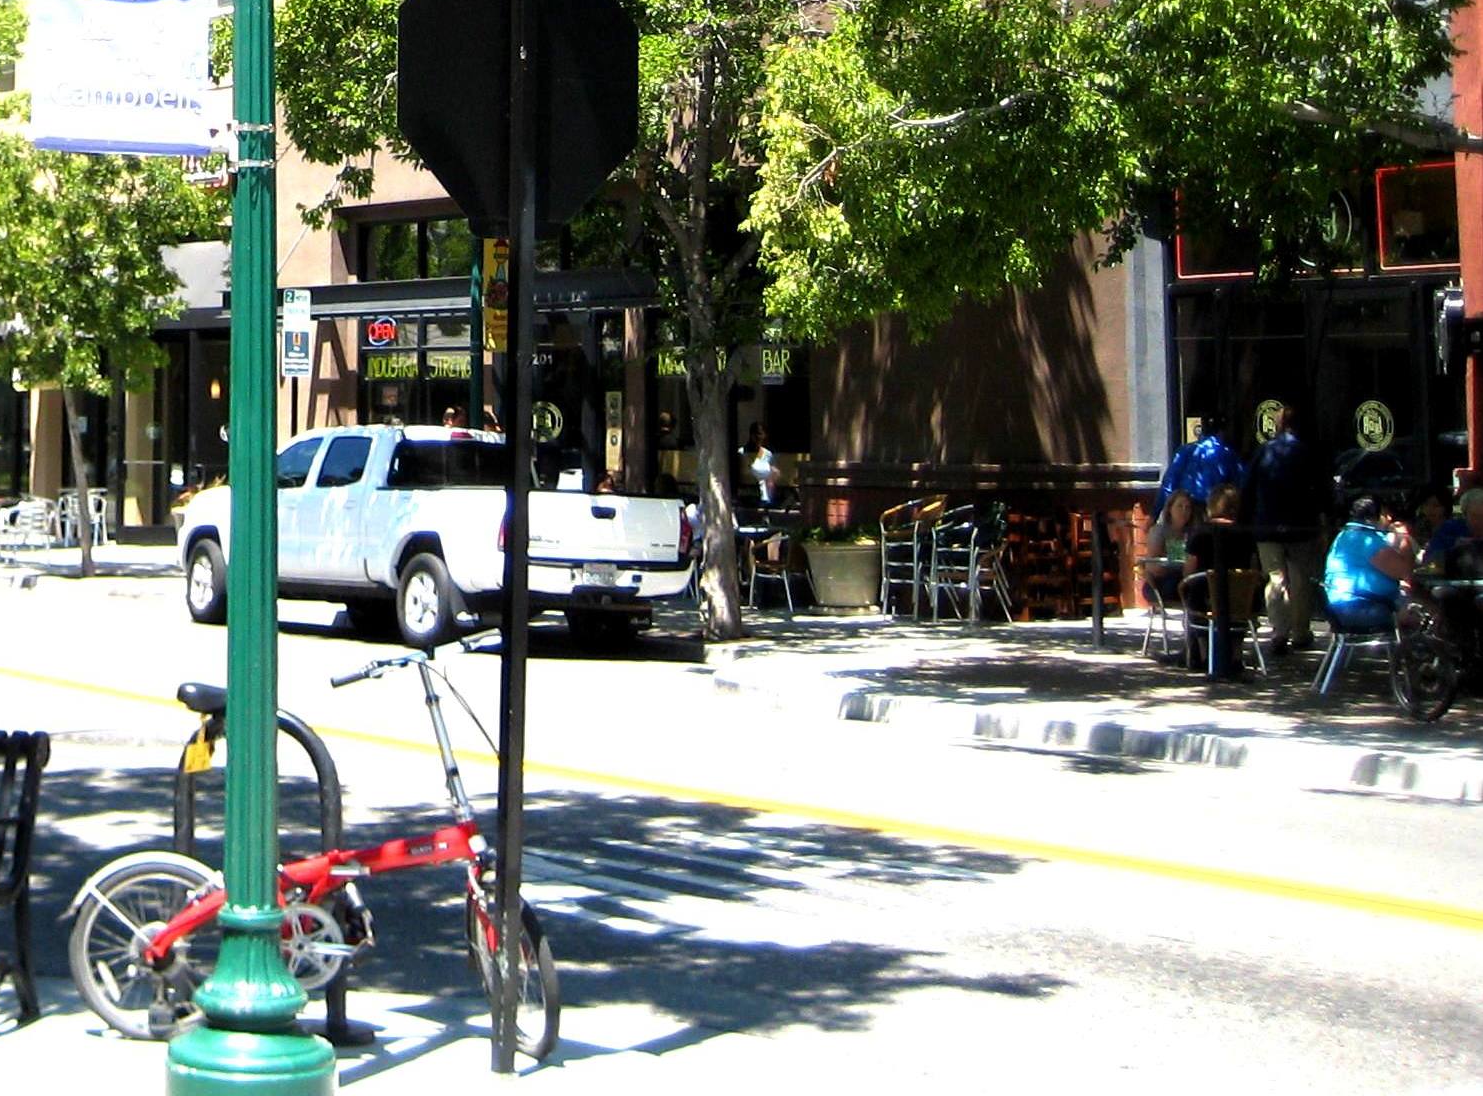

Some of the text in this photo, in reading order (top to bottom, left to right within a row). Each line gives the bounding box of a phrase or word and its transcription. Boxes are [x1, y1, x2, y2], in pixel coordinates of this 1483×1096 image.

[368, 323, 397, 340] OPEN
[532, 353, 553, 365] 201
[762, 349, 792, 374] BAR
